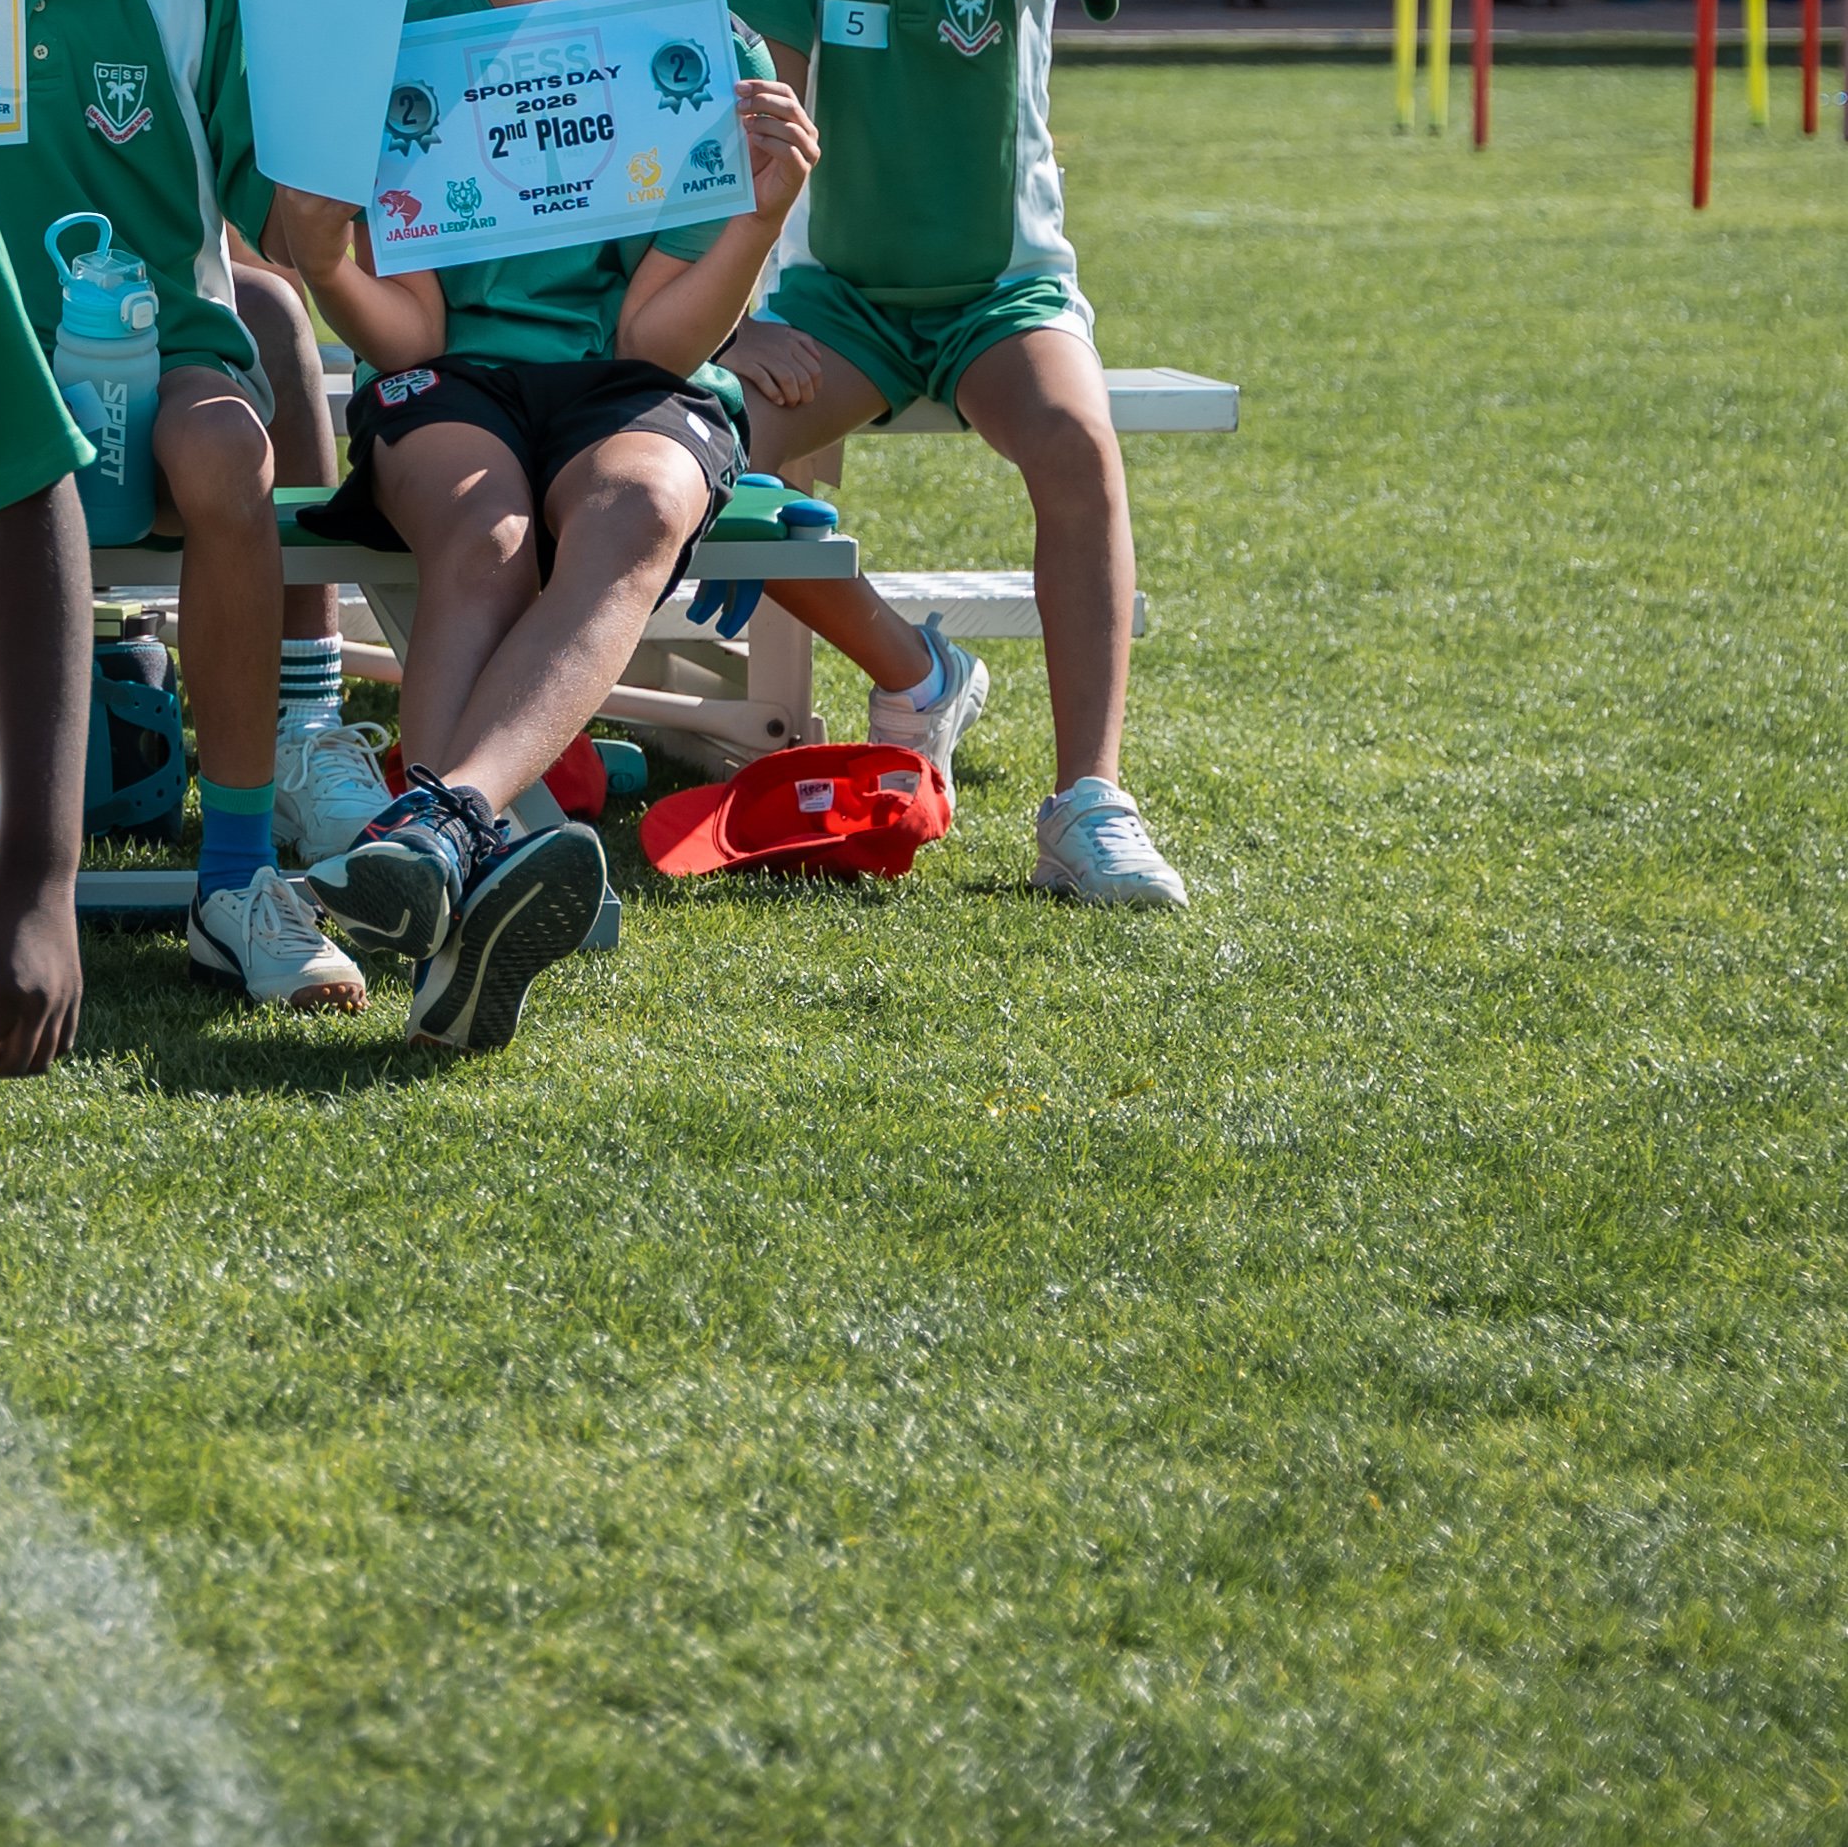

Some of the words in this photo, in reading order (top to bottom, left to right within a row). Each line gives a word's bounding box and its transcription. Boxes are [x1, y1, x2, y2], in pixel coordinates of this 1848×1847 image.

[845, 11, 864, 36] 5
[98, 68, 143, 81] DESS
[463, 74, 563, 103] SPORTS
[567, 65, 622, 86] DAY
[516, 93, 577, 114] 2026
[488, 119, 528, 159] 2nd
[535, 113, 615, 151] Place
[518, 179, 595, 201] SPRINT
[683, 174, 737, 194] PANTHER
[532, 196, 591, 215] RACE
[627, 187, 666, 204] LYNX
[386, 224, 439, 242] JAGUAR
[440, 216, 497, 234] LEOPARD
[100, 379, 128, 486] SPORT
